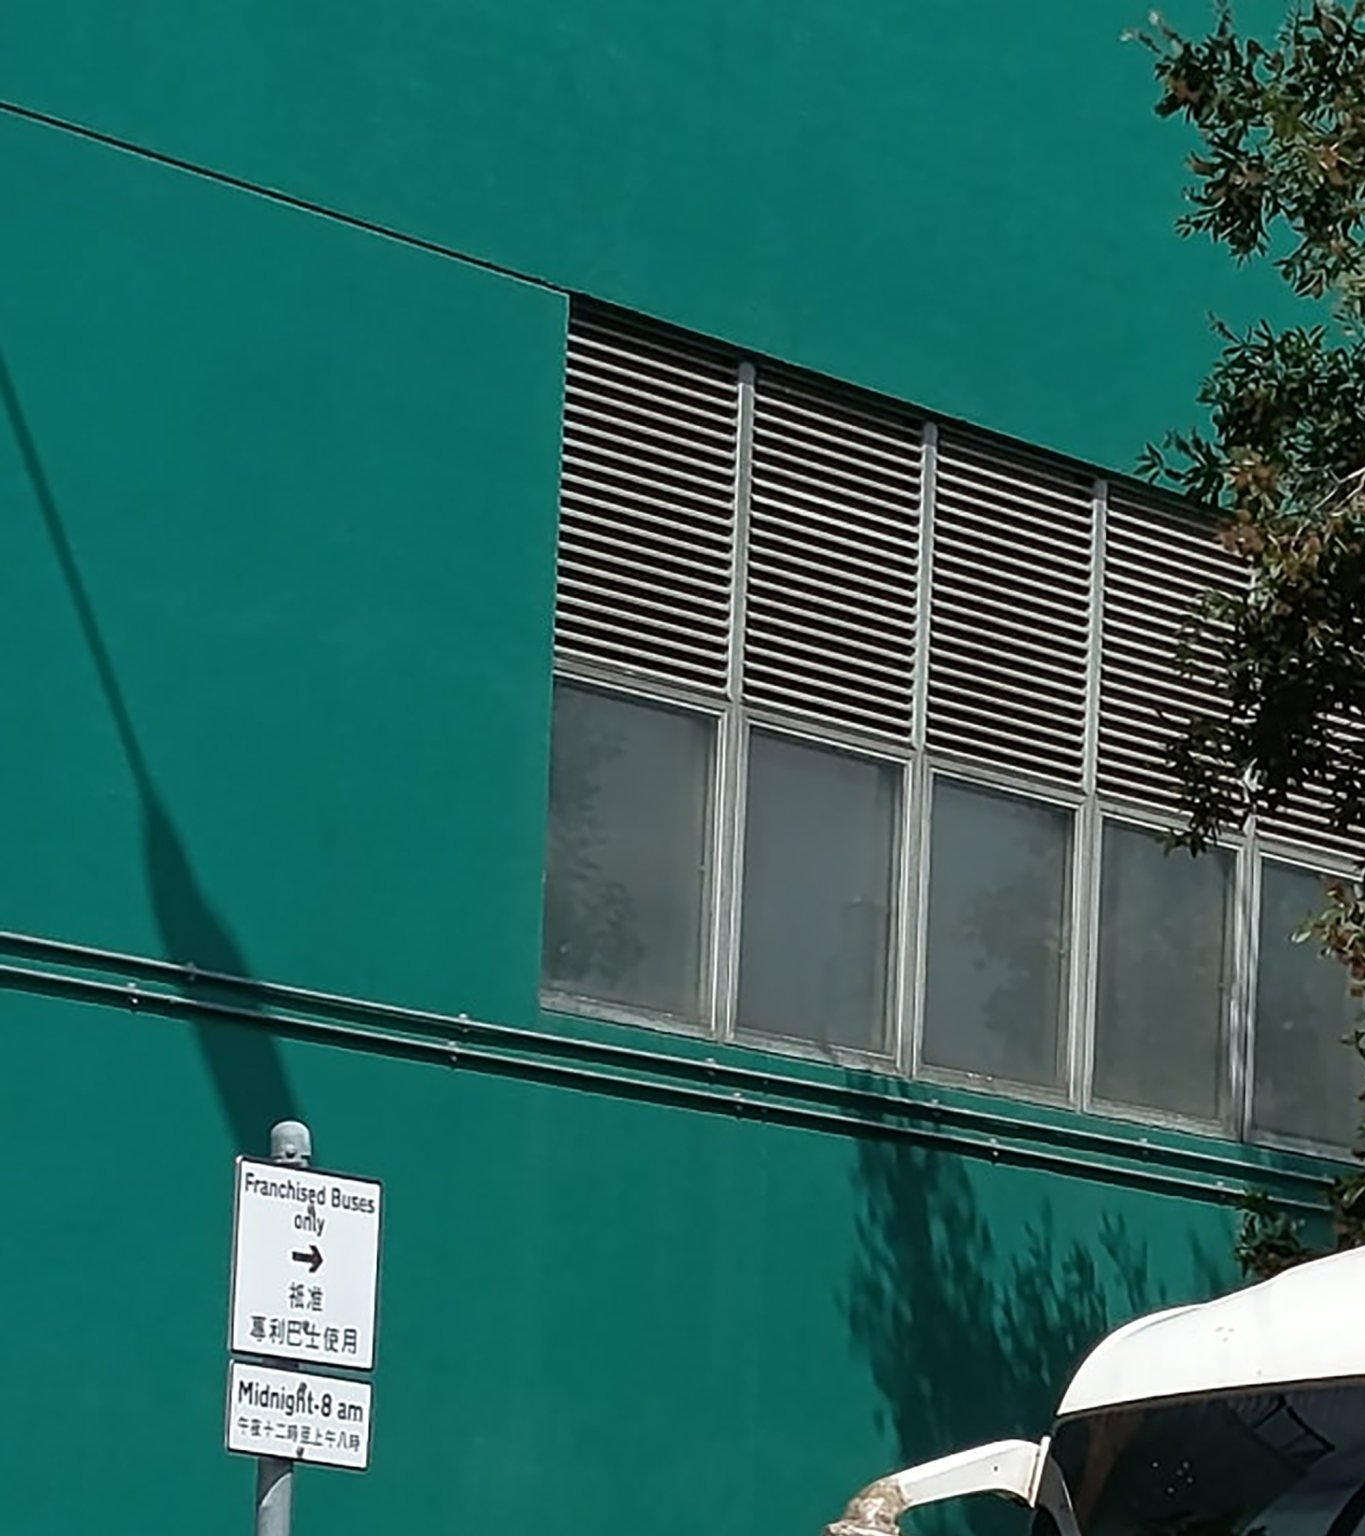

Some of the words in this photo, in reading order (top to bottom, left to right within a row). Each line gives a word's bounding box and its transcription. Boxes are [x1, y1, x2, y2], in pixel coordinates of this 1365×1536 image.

[244, 1172, 326, 1206] Franchised
[331, 1186, 375, 1214] Buses
[294, 1208, 325, 1237] only
[249, 1315, 358, 1355] 專利巴士使用
[337, 1402, 364, 1423] am
